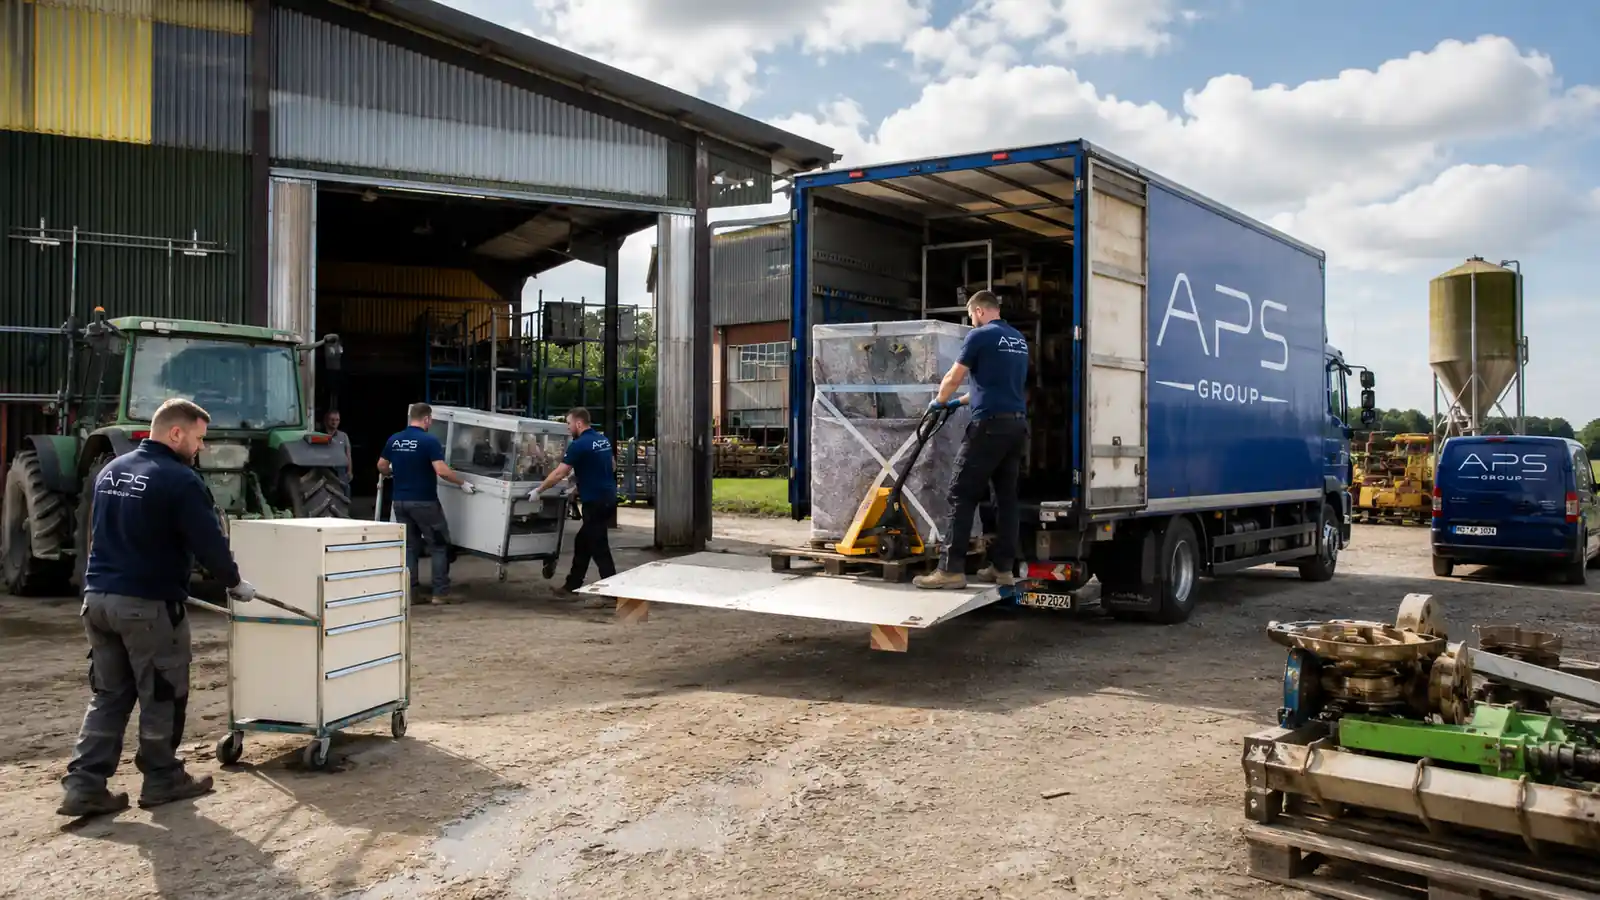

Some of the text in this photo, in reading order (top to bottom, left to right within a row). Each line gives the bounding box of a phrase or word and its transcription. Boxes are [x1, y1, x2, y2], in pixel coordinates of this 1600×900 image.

[1156, 272, 1289, 371] APS
[998, 335, 1028, 349] APS
[1198, 379, 1259, 404] GROUP
[392, 439, 418, 448] APS
[1458, 453, 1548, 472] APS
[96, 470, 150, 491] APS
[1035, 594, 1047, 604] AP
[1048, 595, 1069, 607] 2024
